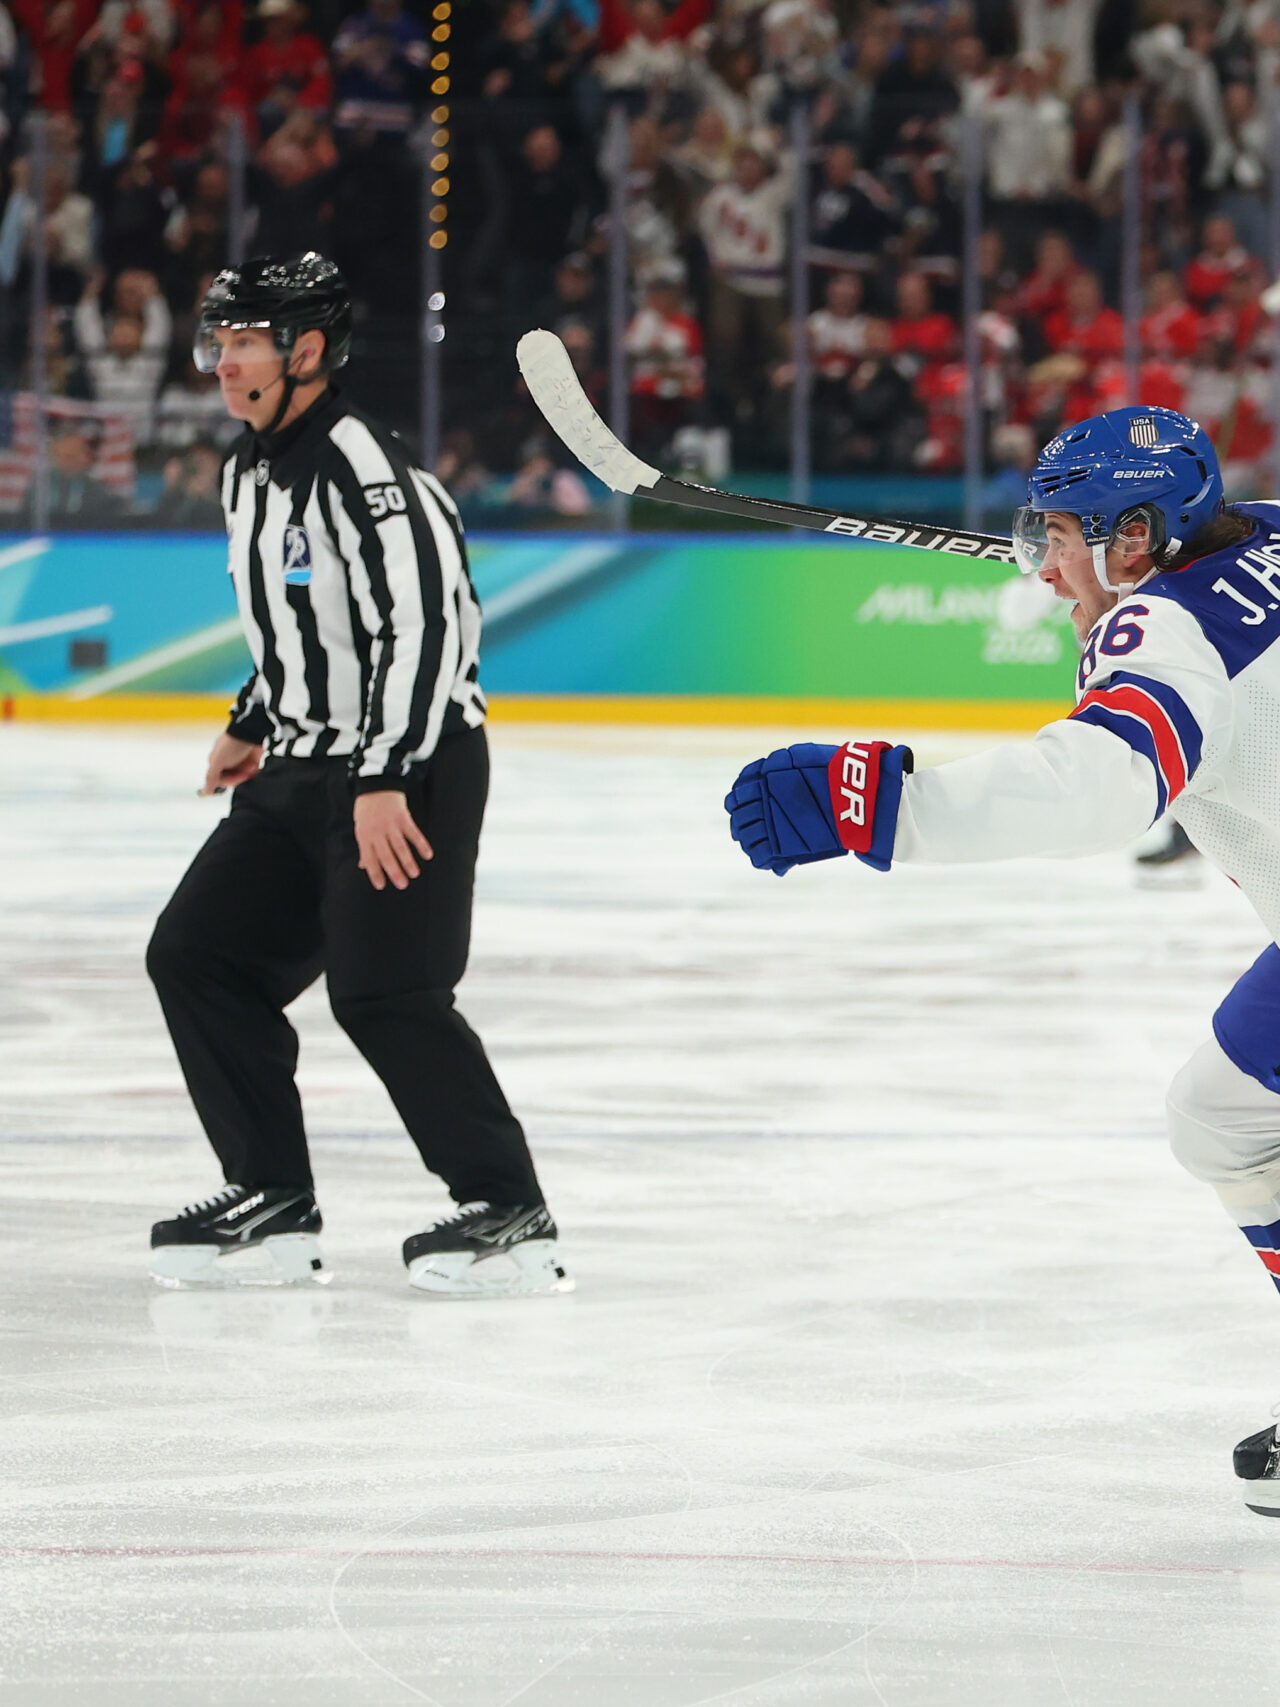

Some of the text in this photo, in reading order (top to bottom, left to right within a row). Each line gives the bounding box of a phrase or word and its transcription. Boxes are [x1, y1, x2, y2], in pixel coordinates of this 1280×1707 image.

[1133, 418, 1150, 426] USA
[1113, 470, 1165, 479] BAUER
[363, 485, 408, 518] 50
[824, 516, 1016, 564] BAUER
[840, 740, 873, 827] UER
